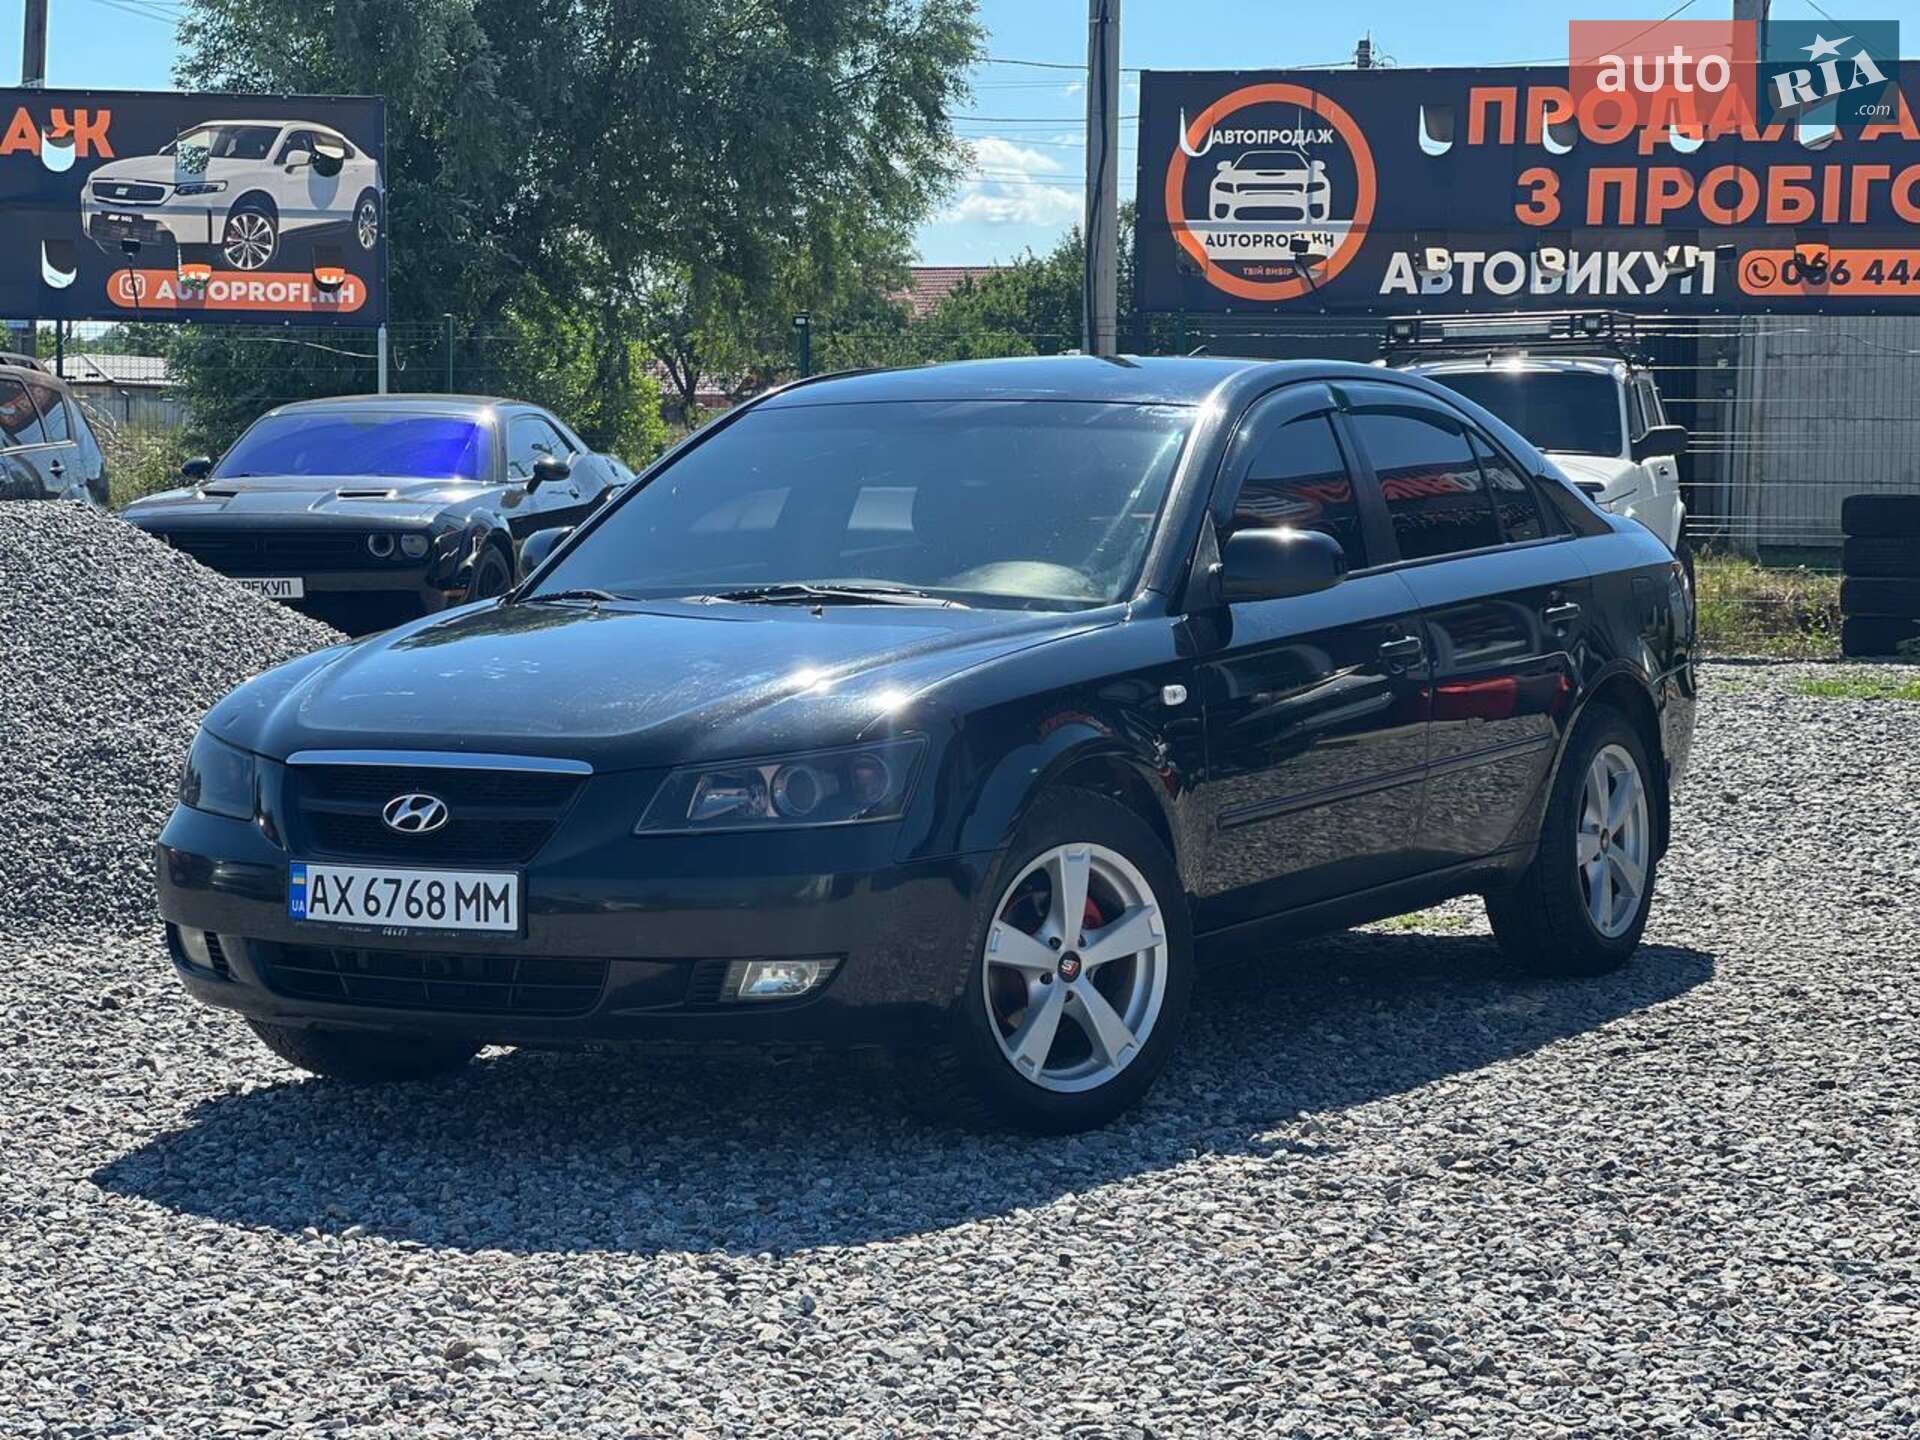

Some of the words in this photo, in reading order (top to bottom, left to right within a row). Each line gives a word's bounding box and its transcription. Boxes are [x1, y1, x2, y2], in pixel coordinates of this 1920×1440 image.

[1213, 129, 1334, 145] АВТОПРОДАЖ
[1379, 246, 1715, 295] АВТОВИКУП
[291, 900, 306, 913] UA
[309, 874, 355, 916] AX
[363, 876, 447, 921] 6768
[455, 880, 511, 924] MM
